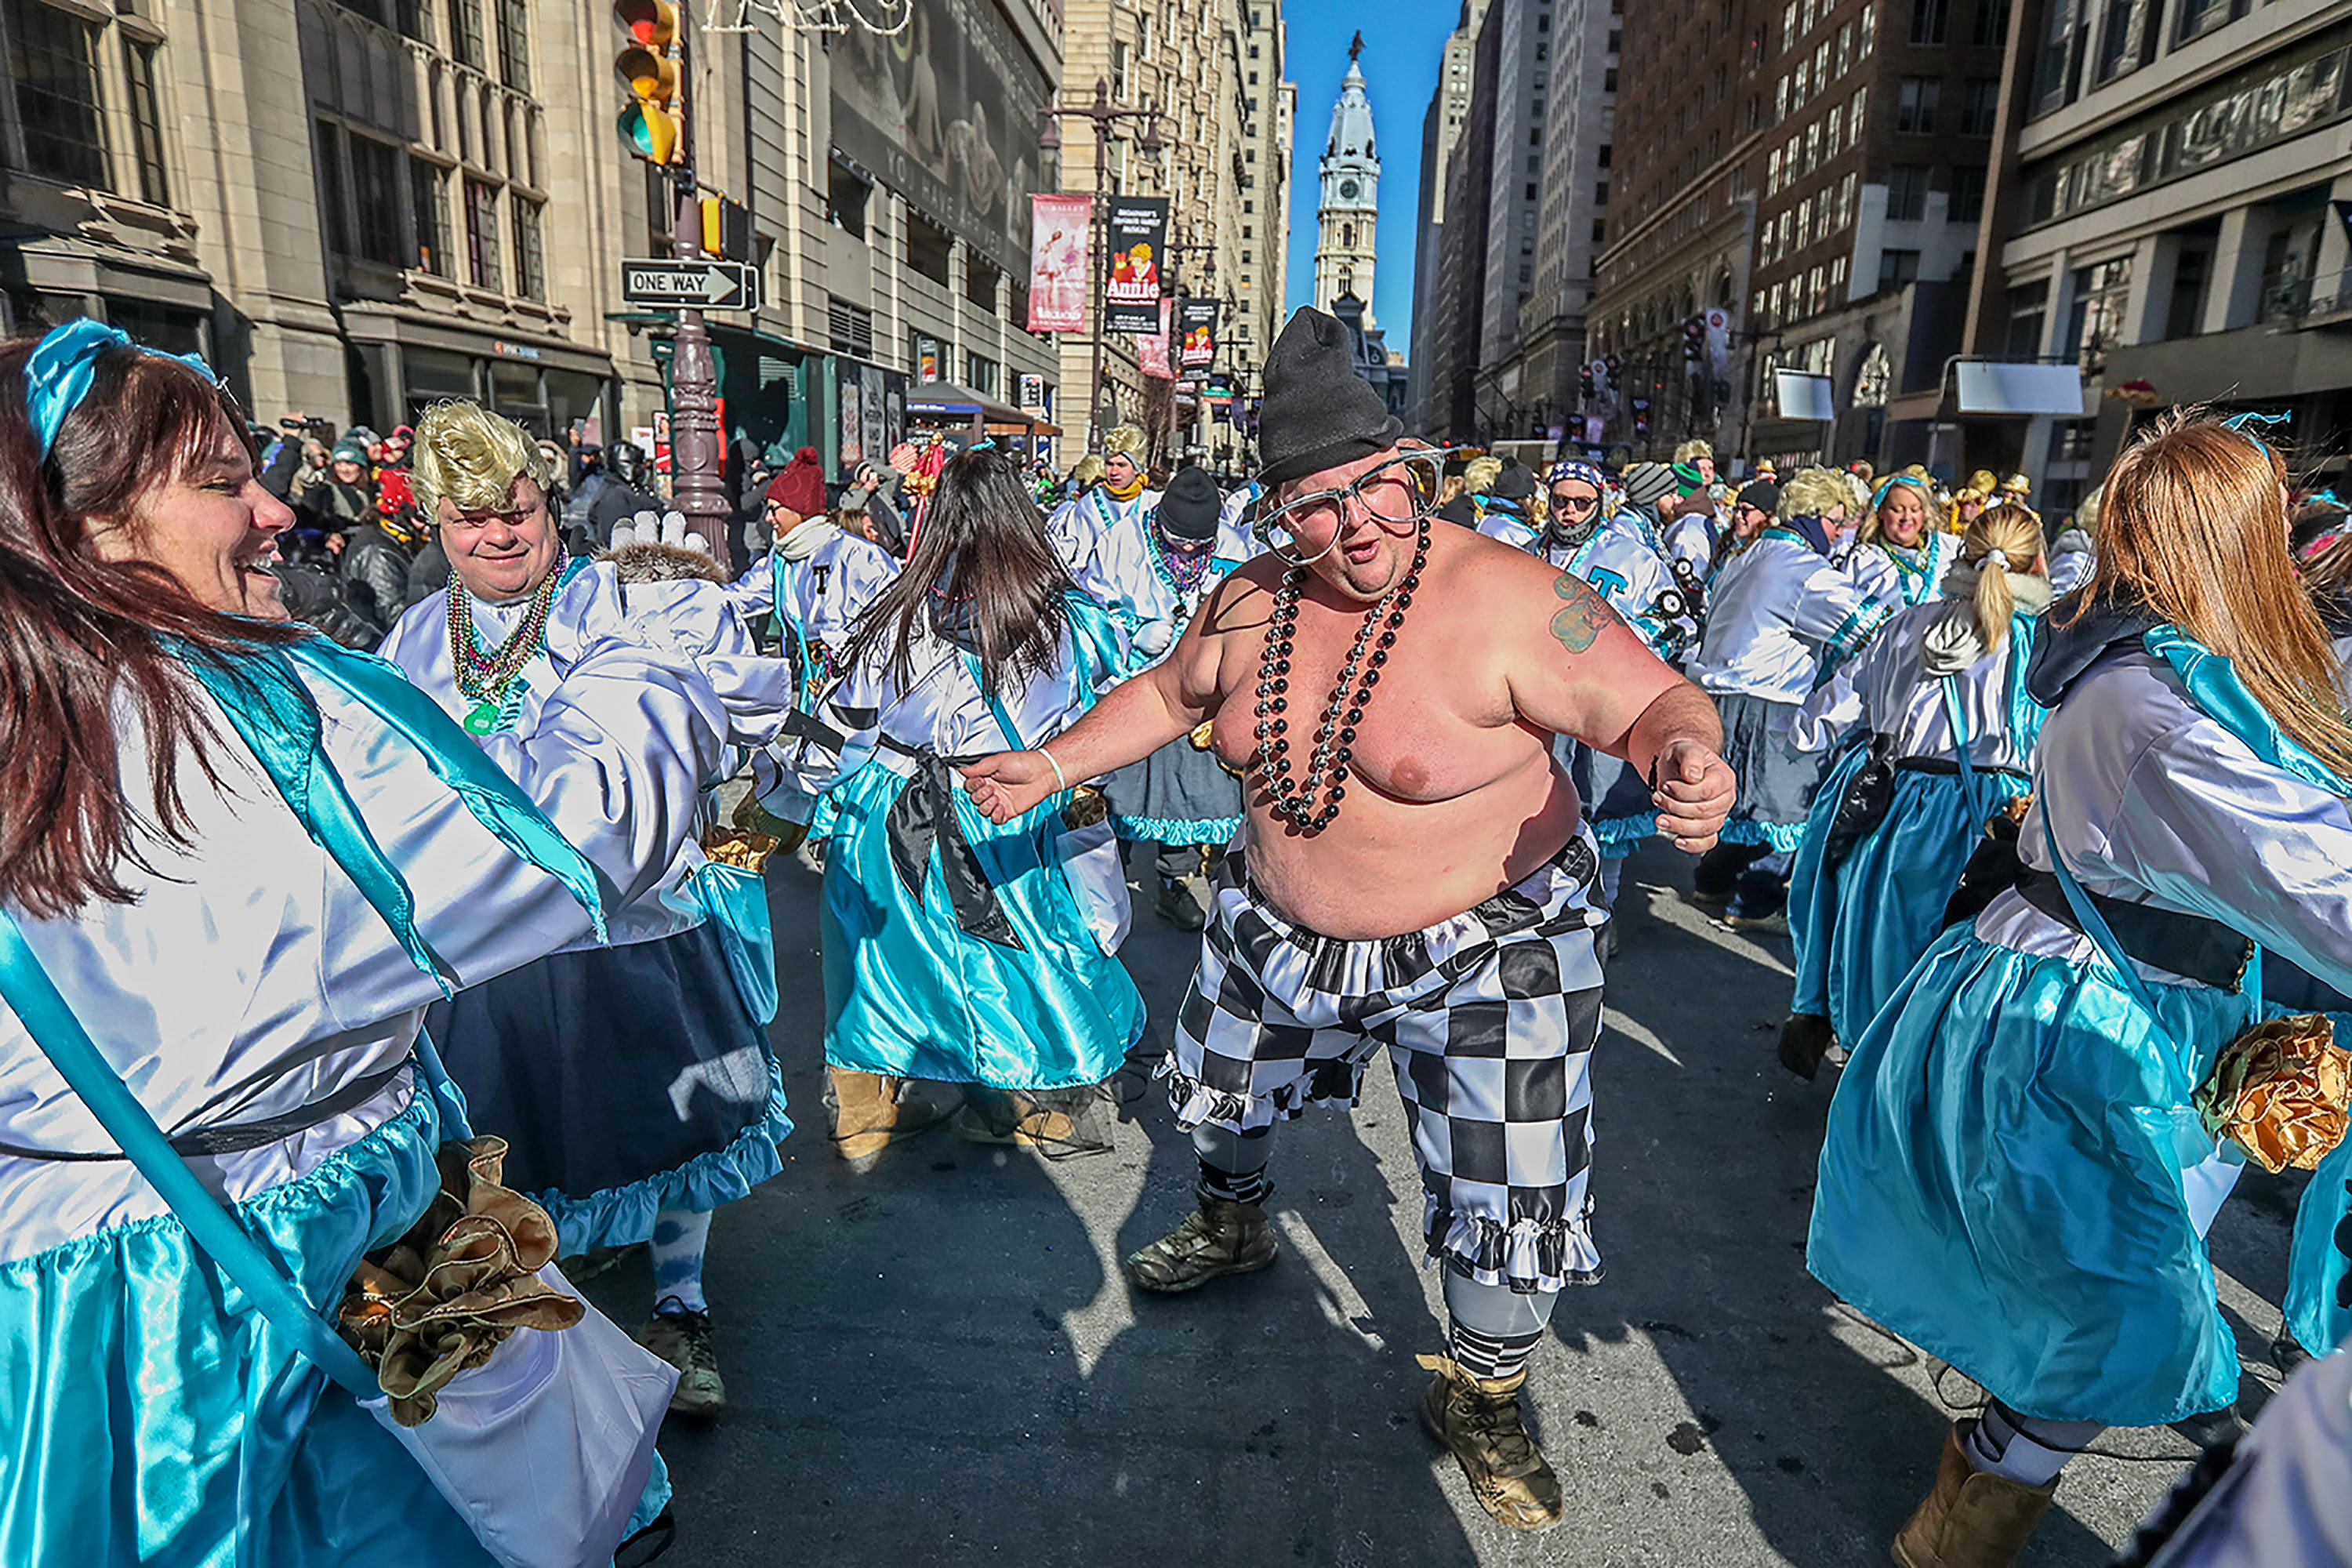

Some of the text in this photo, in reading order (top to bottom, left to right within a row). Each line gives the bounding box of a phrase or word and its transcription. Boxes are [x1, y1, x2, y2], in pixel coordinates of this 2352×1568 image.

[633, 274, 706, 292] ONE WAY
[1106, 277, 1160, 299] Annie
[812, 564, 830, 594] T
[1587, 564, 1629, 600] T
